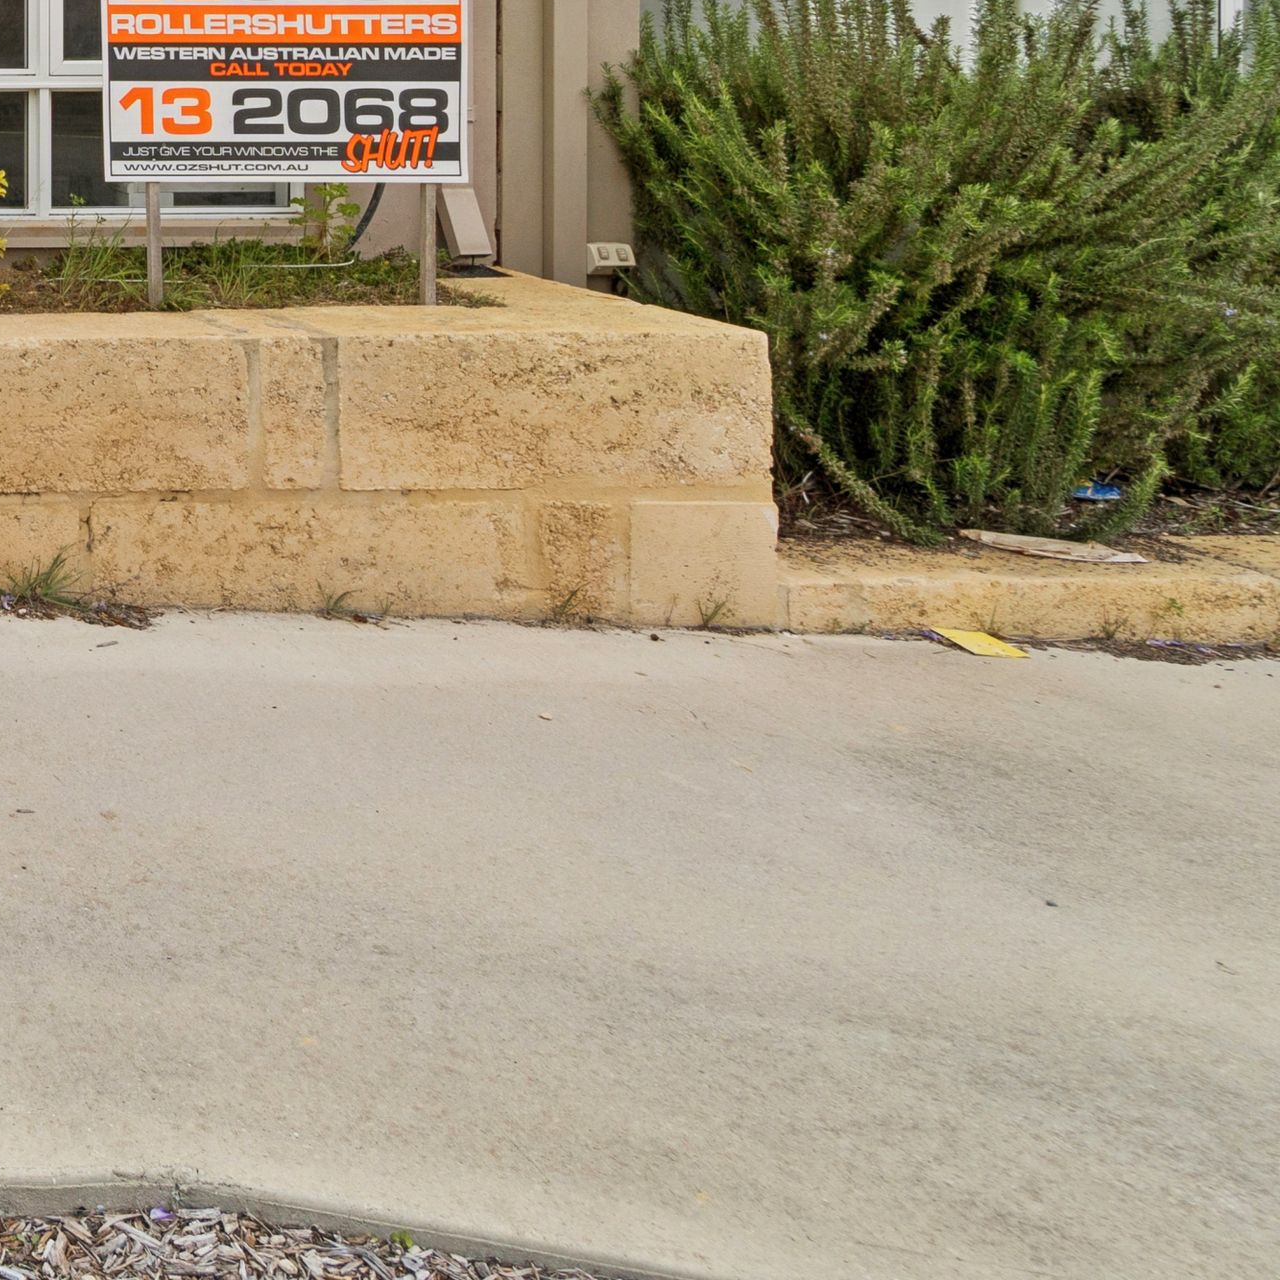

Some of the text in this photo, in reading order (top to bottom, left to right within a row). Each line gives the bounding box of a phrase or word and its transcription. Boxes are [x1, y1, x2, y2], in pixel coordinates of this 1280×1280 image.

[110, 13, 458, 36] ROLLERSHUTTERS
[113, 46, 457, 61] WESTERN AUSTRALIAN MADE
[210, 62, 353, 77] CALL TODAY
[118, 87, 449, 135] 13 2068
[122, 125, 440, 173] JUST GIVE YOUR WINDOWS THE SHUT!
[124, 163, 309, 172] WWW.OZSHUT.COM.AU
